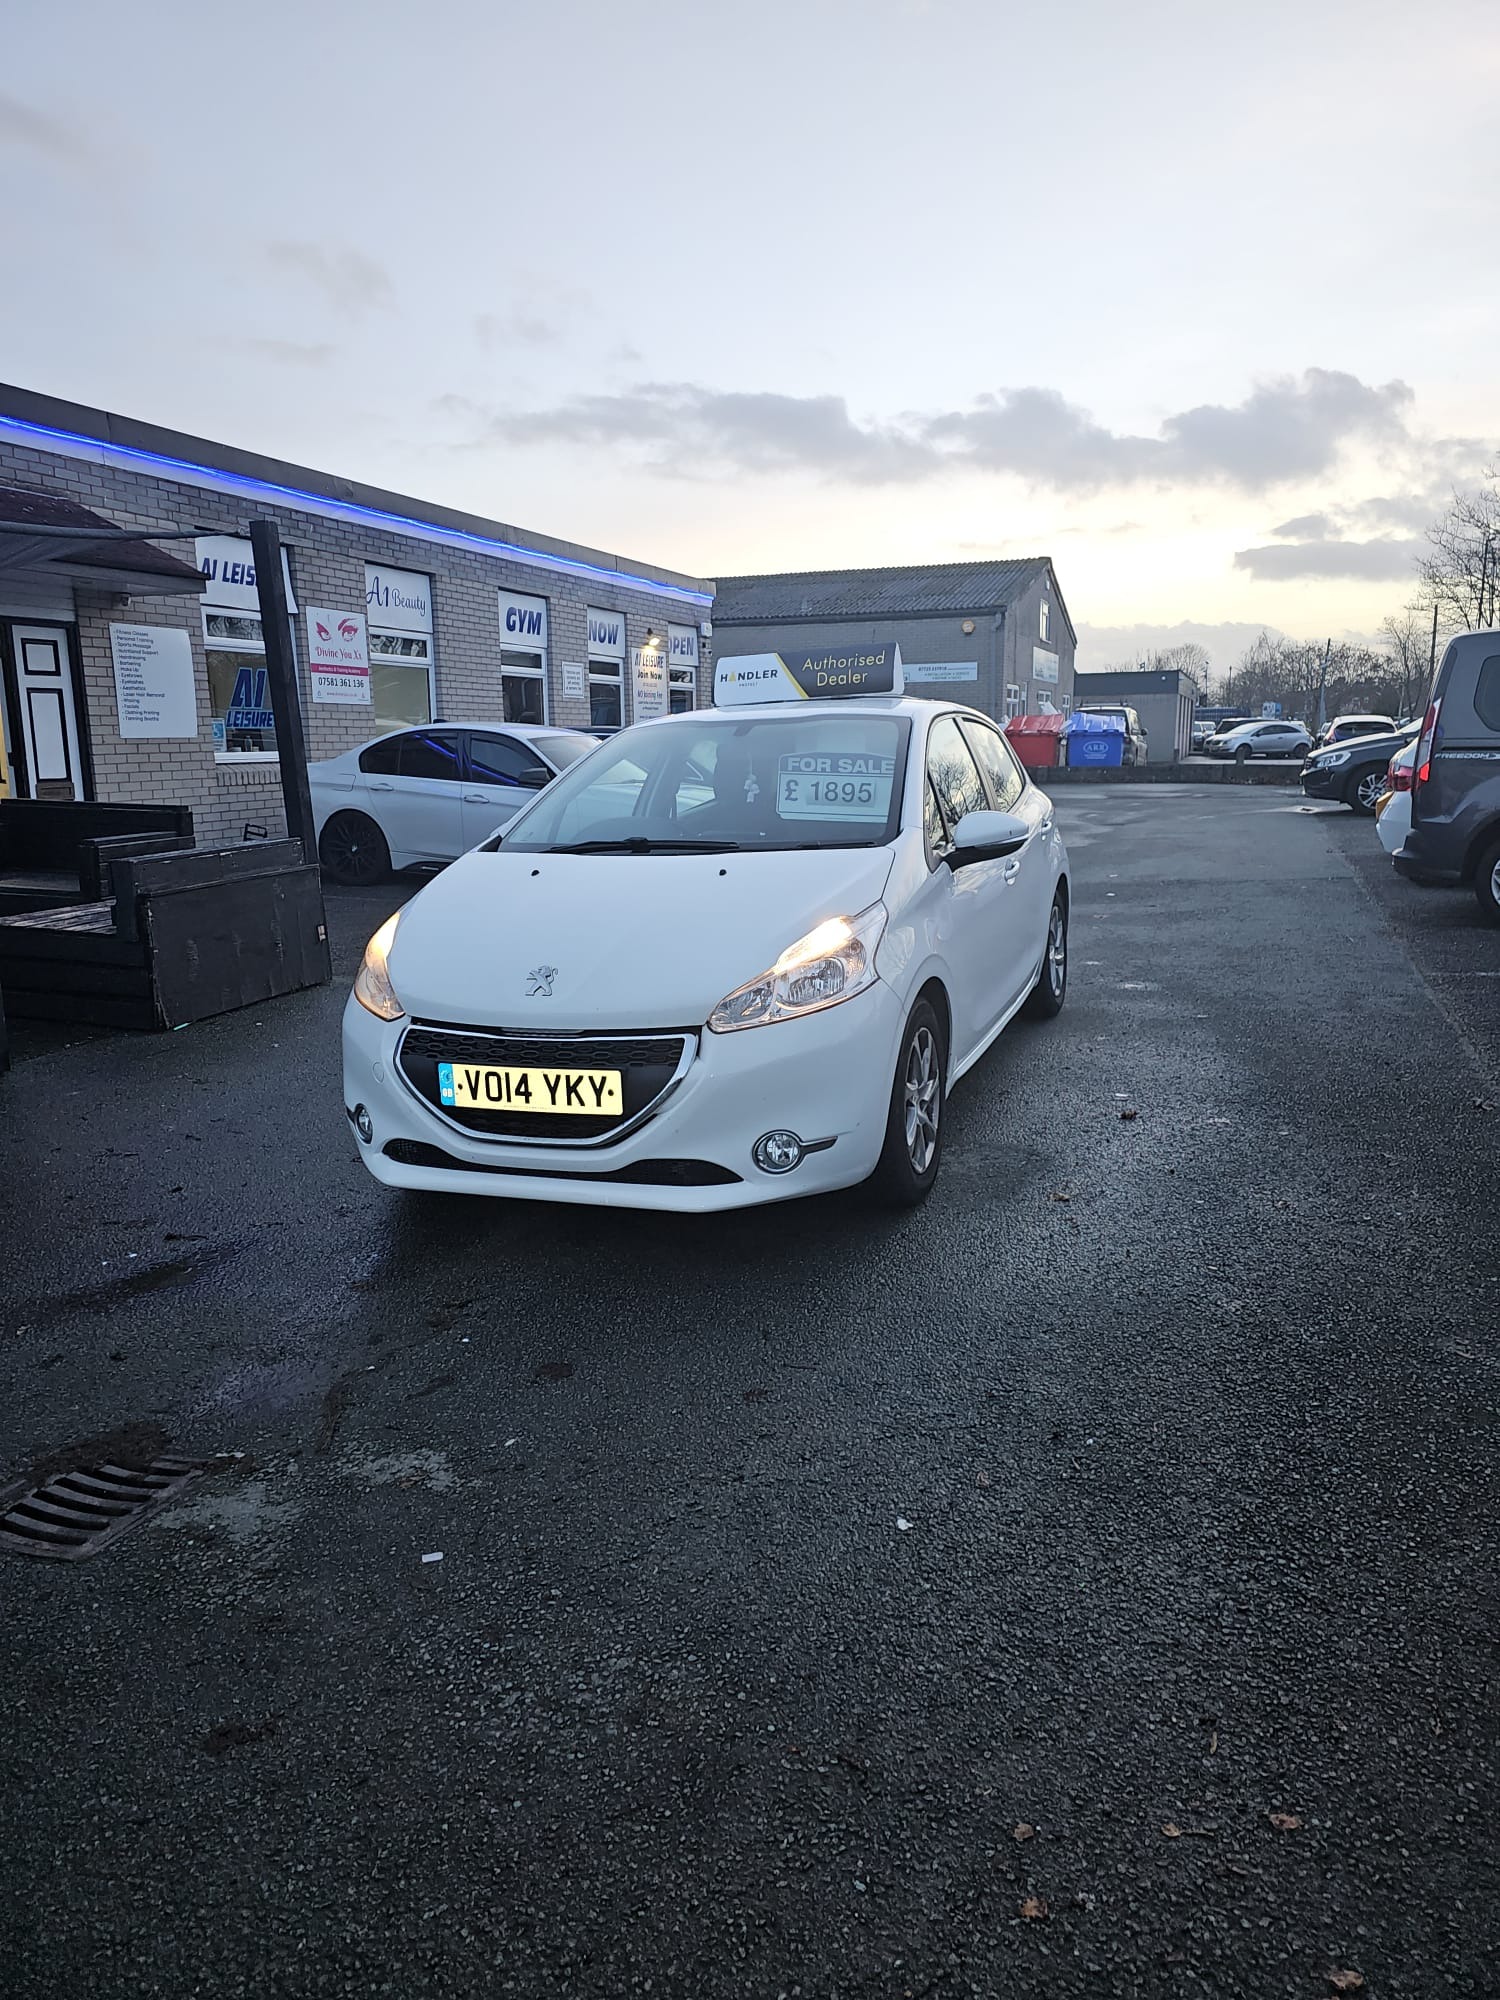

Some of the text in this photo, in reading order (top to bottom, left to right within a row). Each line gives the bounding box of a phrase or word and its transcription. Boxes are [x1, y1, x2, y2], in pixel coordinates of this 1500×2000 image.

[222, 561, 256, 586] LEIS
[366, 576, 426, 617] A1 Beauty
[506, 606, 542, 635] GYM
[588, 620, 619, 645] NOW
[642, 654, 664, 668] LEISURE
[802, 649, 885, 672] Authorised
[318, 677, 364, 688] 07581 361 136
[637, 669, 662, 680] Join Now
[817, 669, 868, 687] Dealer
[226, 710, 274, 729] LEISURE
[787, 757, 895, 774] FOR SALE
[784, 779, 872, 803] £ 1895
[464, 1069, 607, 1107] VO14 YKY
